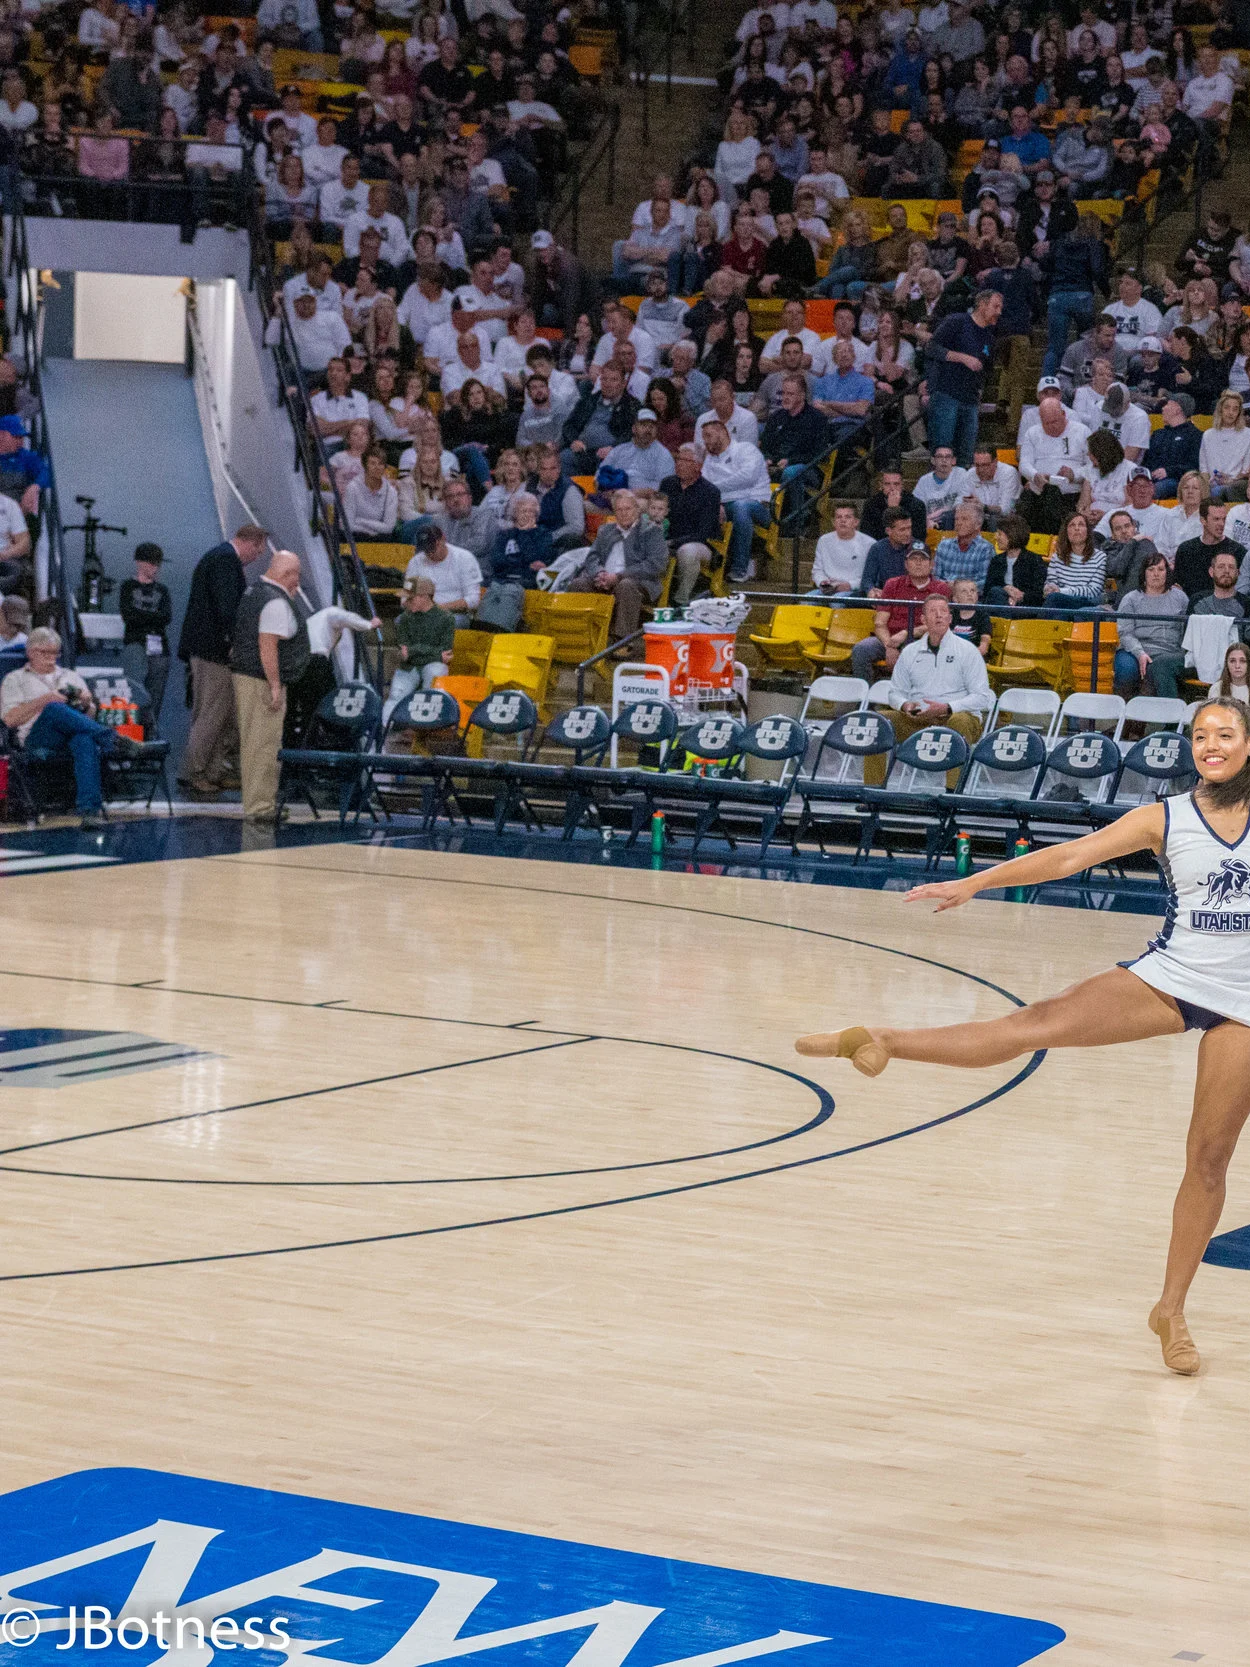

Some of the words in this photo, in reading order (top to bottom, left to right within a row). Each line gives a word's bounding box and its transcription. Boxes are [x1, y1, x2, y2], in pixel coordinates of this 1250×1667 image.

[723, 643, 734, 661] G
[621, 686, 660, 696] GATORADE
[1190, 910, 1231, 932] UTAH
